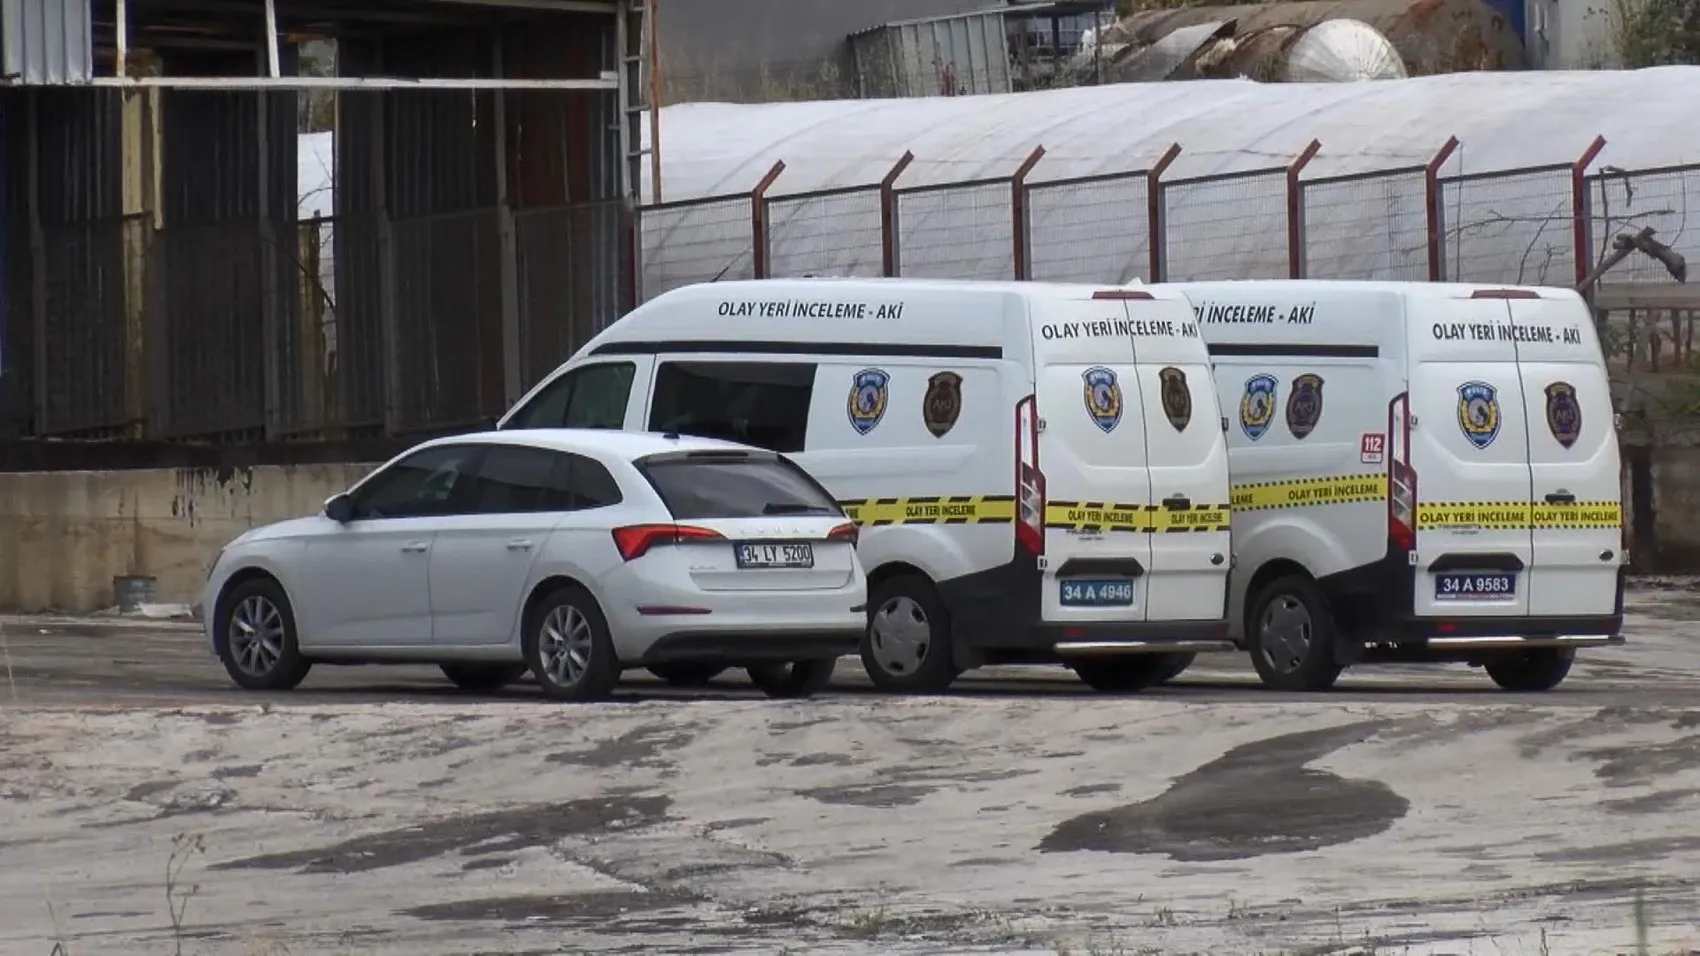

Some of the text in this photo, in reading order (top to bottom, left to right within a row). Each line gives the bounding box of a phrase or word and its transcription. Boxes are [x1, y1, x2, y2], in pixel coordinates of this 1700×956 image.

[718, 301, 756, 317] OLAY
[759, 299, 791, 318] YERİ
[793, 300, 867, 319] İNCELEME
[876, 301, 904, 319] AKİ
[1207, 301, 1276, 324] İNCELEME
[1287, 300, 1317, 324] AKİ
[1041, 322, 1080, 340] OLAY
[1082, 318, 1113, 337] YERİ
[1113, 318, 1175, 337] İNCELEME
[1432, 322, 1466, 340] OLAY
[1468, 320, 1495, 340] YERİ
[1497, 320, 1553, 343] İNCELEME
[1563, 323, 1582, 345] AKİ
[1365, 437, 1382, 451] 112
[1288, 489, 1310, 500] OLAY
[1334, 484, 1378, 497] İNCELEME
[906, 505, 923, 517] OLAY
[1068, 510, 1086, 521] OLAY
[1420, 511, 1450, 523] OLAY
[1477, 511, 1525, 523] İNCELEME
[1534, 511, 1557, 522] OLAY
[743, 545, 811, 562] 34 LY 5200
[1064, 584, 1132, 600] 34 A 4946
[1444, 577, 1509, 592] 34 A 9583
